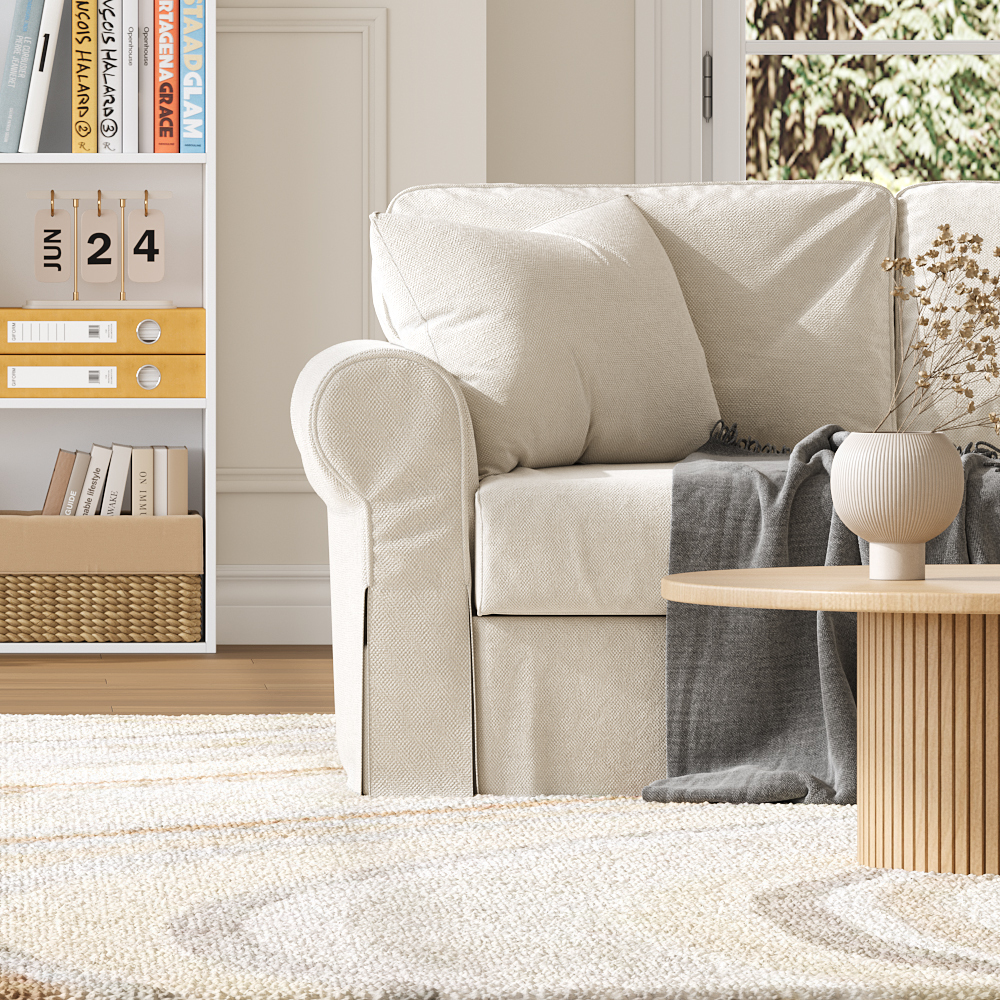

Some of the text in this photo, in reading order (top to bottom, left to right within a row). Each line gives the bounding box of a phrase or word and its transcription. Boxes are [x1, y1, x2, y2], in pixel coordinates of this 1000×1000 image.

[75, 50, 92, 117] HALARD
[101, 49, 118, 117] HALARD
[44, 229, 159, 271] JUN 2 4
[87, 468, 101, 496] lifestyle
[140, 471, 147, 484] ON
[65, 491, 76, 515] GUIDE
